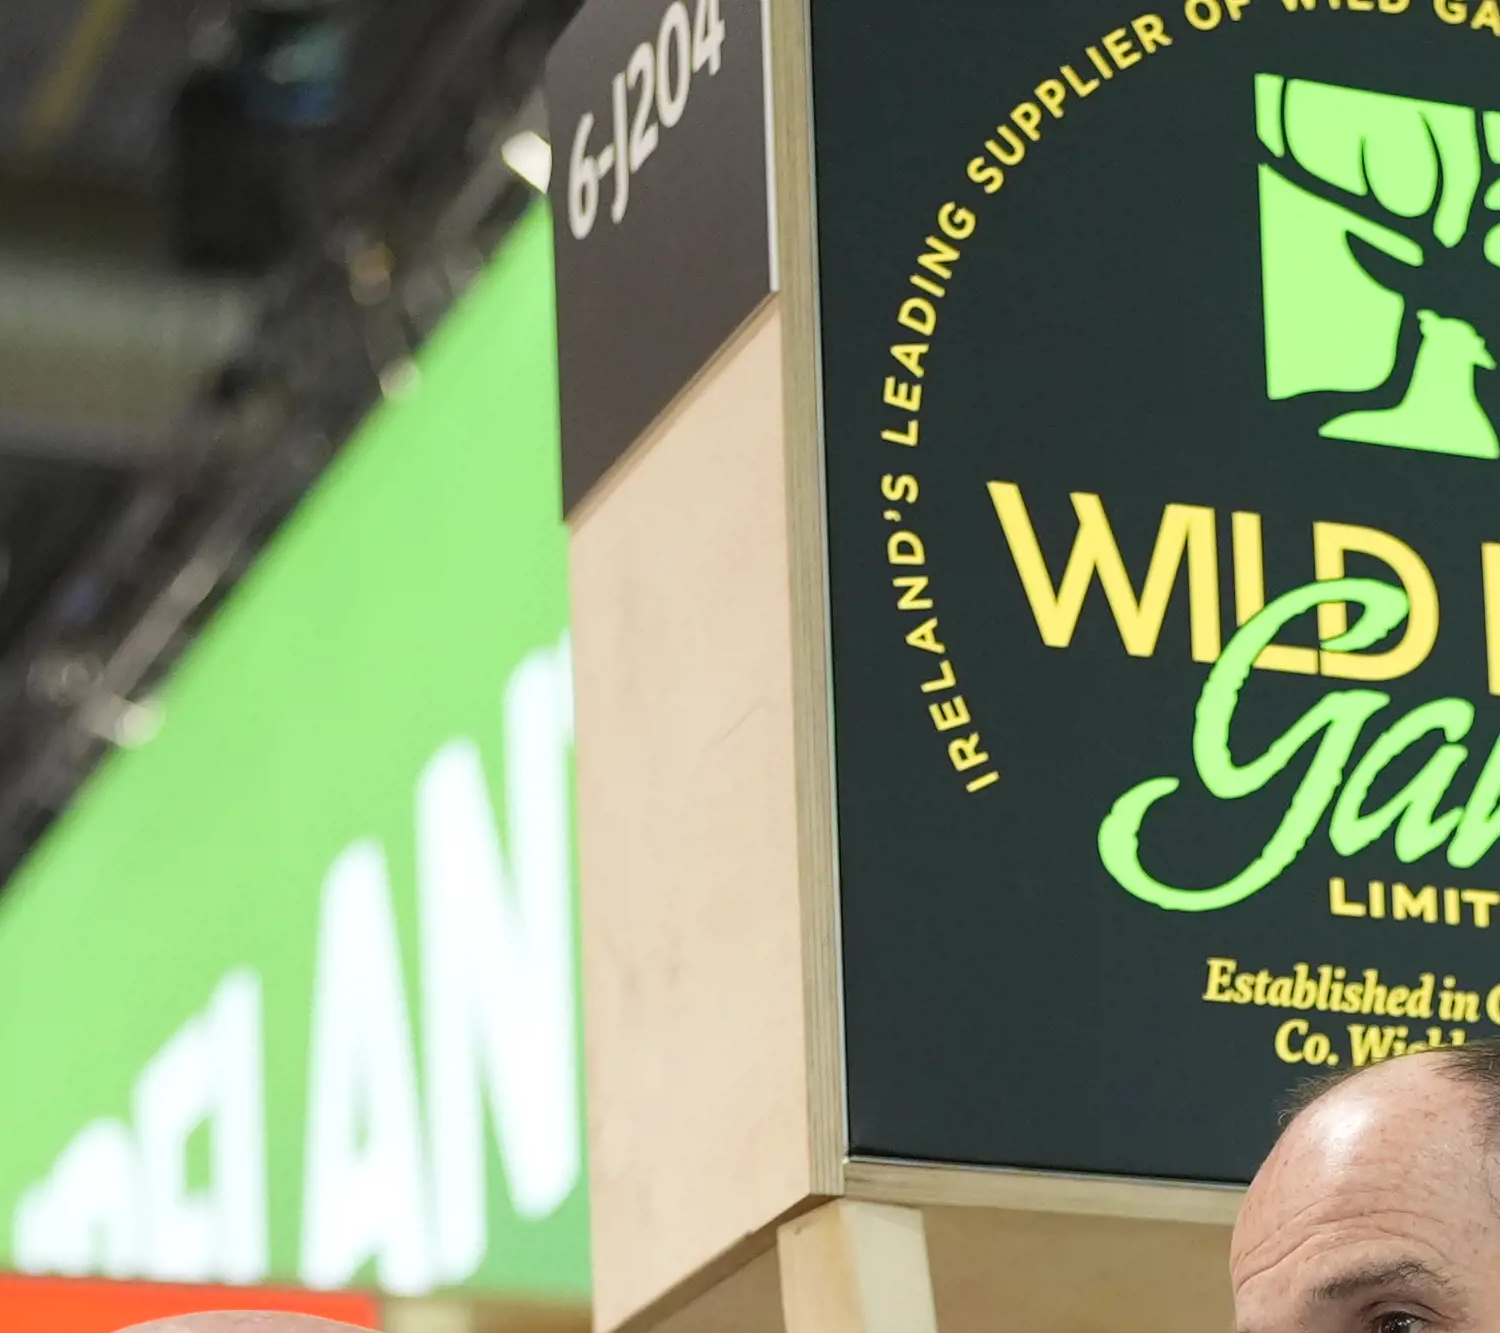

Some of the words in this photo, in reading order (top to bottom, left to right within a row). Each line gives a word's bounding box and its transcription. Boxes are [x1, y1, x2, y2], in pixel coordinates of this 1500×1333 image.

[567, 0, 726, 240] 6-J204
[967, 14, 1172, 194] SUPPLIER
[881, 202, 976, 446] LEADING
[881, 474, 1000, 793] IRELAND'S
[987, 480, 1440, 681] WILD
[1204, 957, 1435, 1019] Established
[1439, 976, 1480, 1022] in
[1274, 1018, 1339, 1067] Co.
